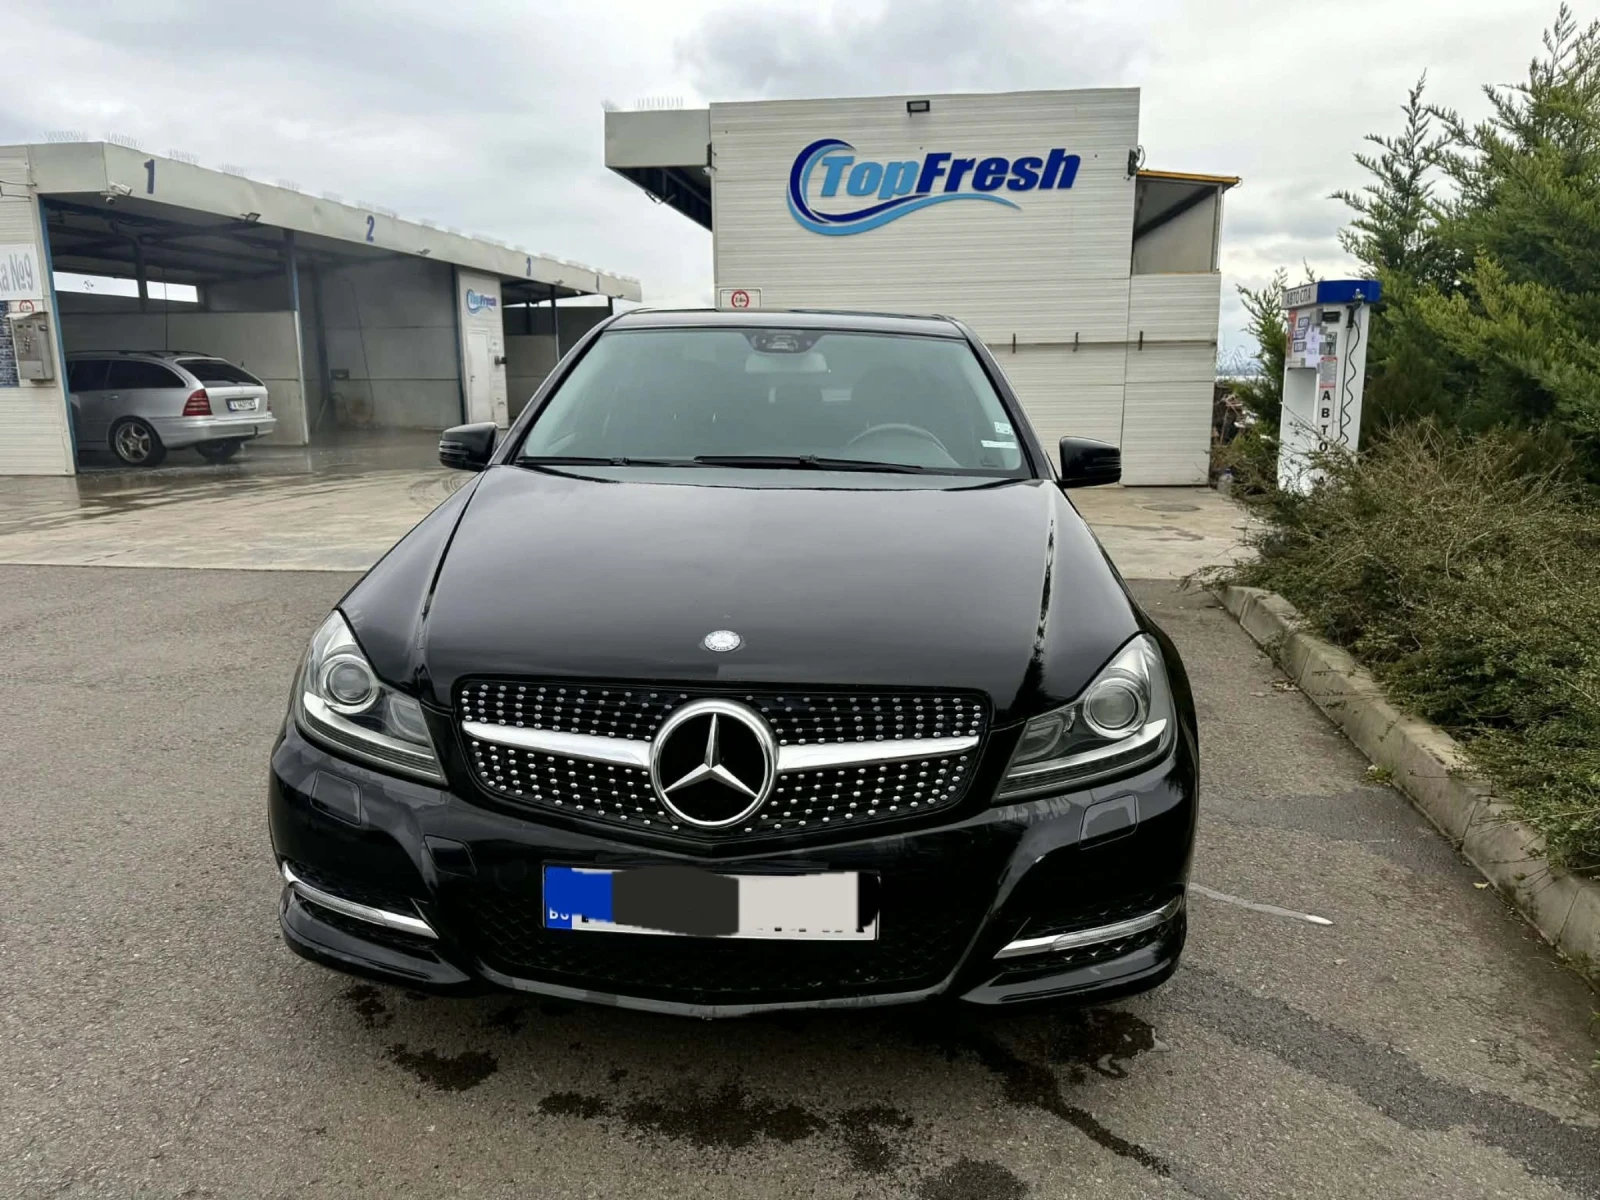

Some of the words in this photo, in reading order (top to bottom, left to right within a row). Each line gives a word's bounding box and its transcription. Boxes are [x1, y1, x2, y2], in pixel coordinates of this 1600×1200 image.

[144, 159, 155, 194] 1
[820, 148, 1081, 200] TopFresh
[366, 215, 375, 242] 2
[526, 257, 532, 277] 3
